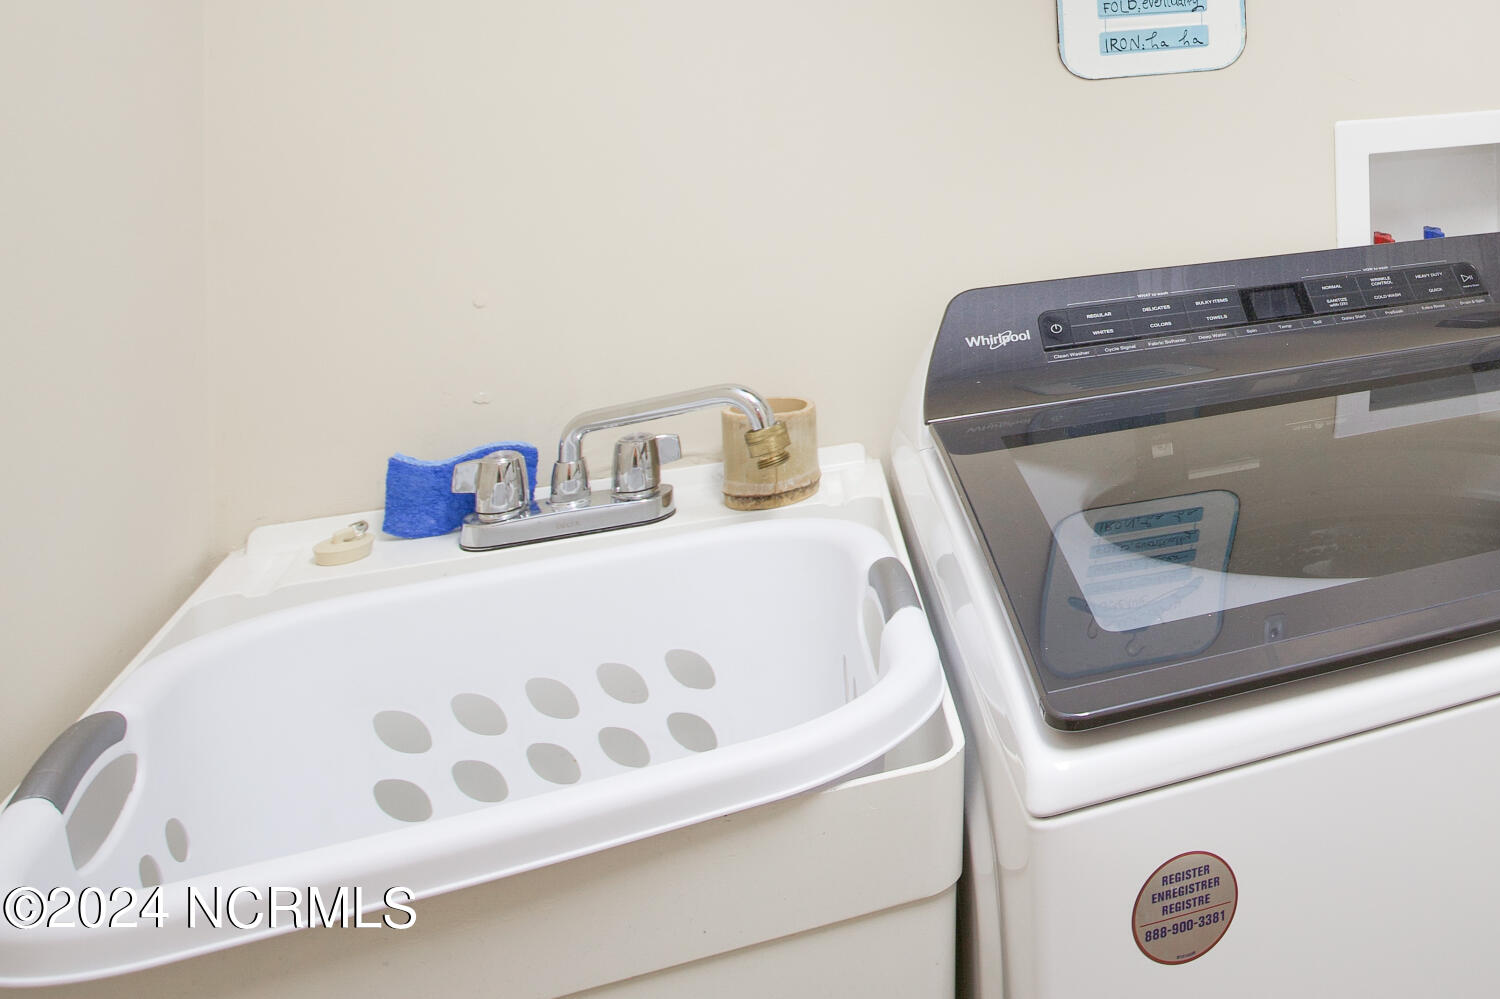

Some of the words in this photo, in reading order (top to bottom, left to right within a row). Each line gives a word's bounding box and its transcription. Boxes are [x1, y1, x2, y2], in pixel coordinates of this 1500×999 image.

[1086, 311, 1112, 319] REGULAR
[1142, 304, 1171, 312] DELICATES
[965, 329, 1031, 349] Whirlpool
[1092, 328, 1114, 336] WHITES
[1161, 864, 1210, 886] REGISTER
[1151, 876, 1220, 904] ENREGISTRER
[1161, 893, 1211, 916] REGISTRE
[1144, 909, 1225, 942] 888-900-3381
